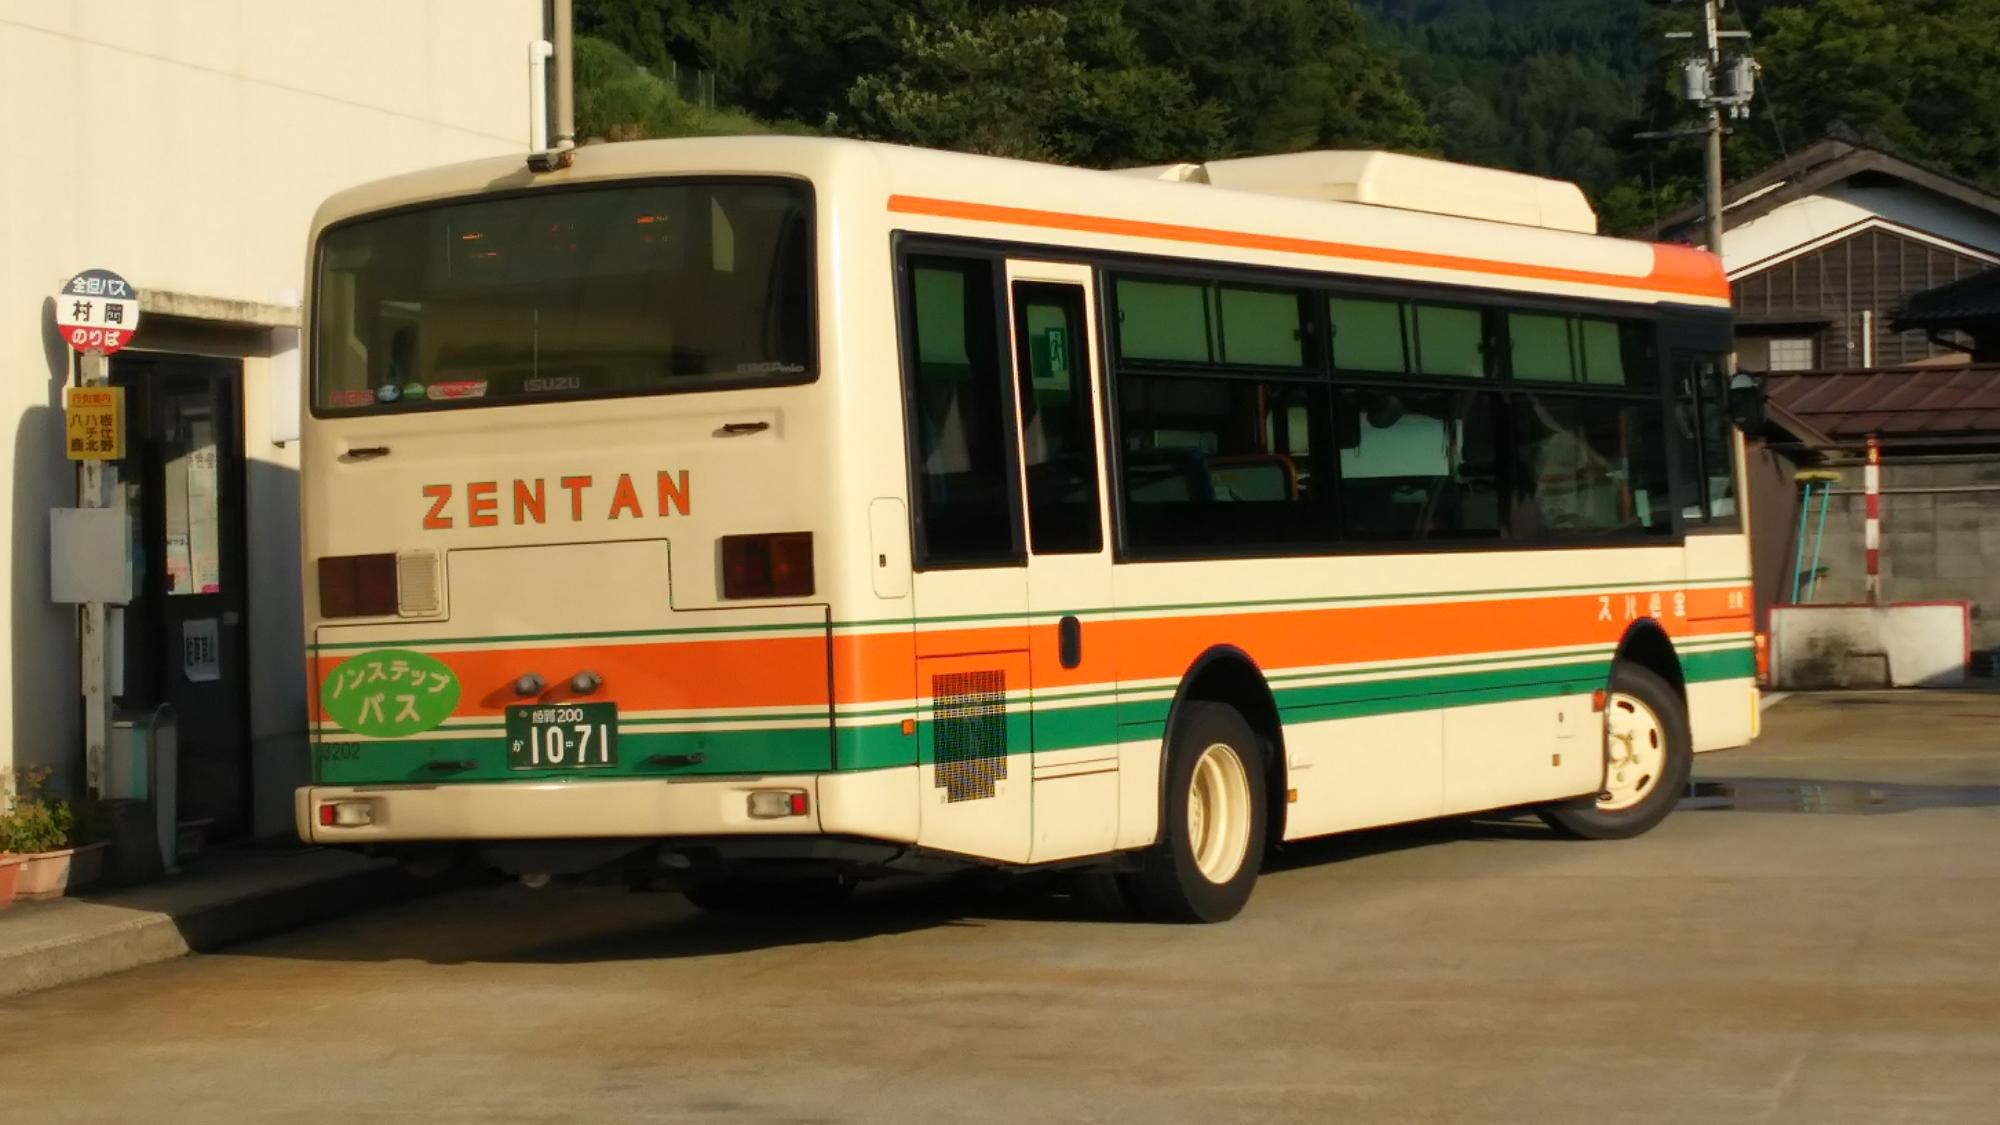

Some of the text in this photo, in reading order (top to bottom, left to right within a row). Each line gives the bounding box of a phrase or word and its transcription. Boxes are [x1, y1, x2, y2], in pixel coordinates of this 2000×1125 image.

[72, 277, 127, 296] 全但バス
[73, 300, 123, 324] 村岡
[72, 329, 121, 347] のりば
[523, 376, 580, 392] ISUZU
[422, 470, 691, 530] ZENTAN
[332, 660, 450, 699] ノンステップ
[358, 693, 420, 725] バス
[512, 740, 524, 752] か
